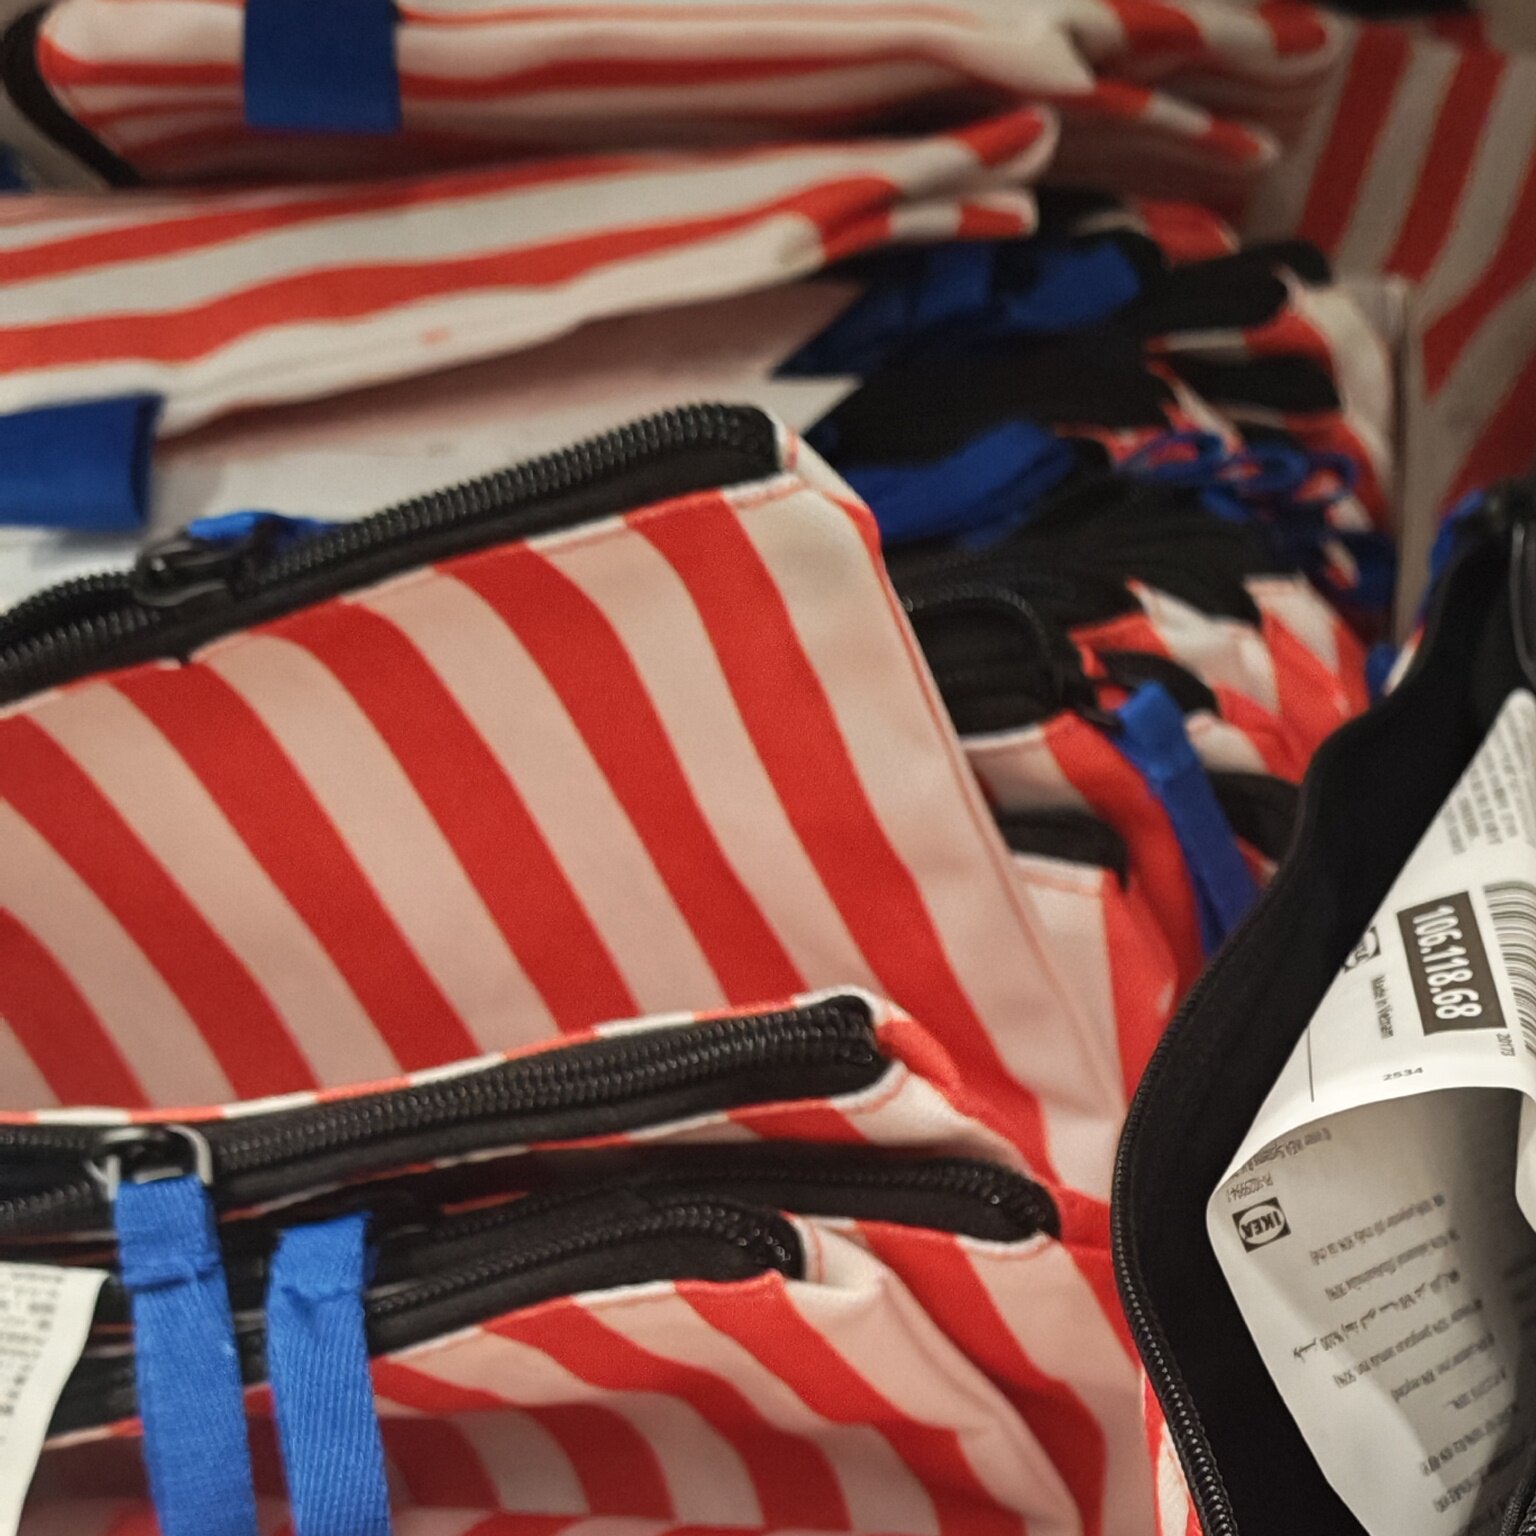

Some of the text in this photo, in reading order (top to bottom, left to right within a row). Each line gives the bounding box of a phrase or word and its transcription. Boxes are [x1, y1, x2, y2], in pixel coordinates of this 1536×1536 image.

[1412, 904, 1483, 1020] 106.118.68
[1382, 1066, 1424, 1082] 2534
[1240, 1210, 1282, 1240] IKEA
